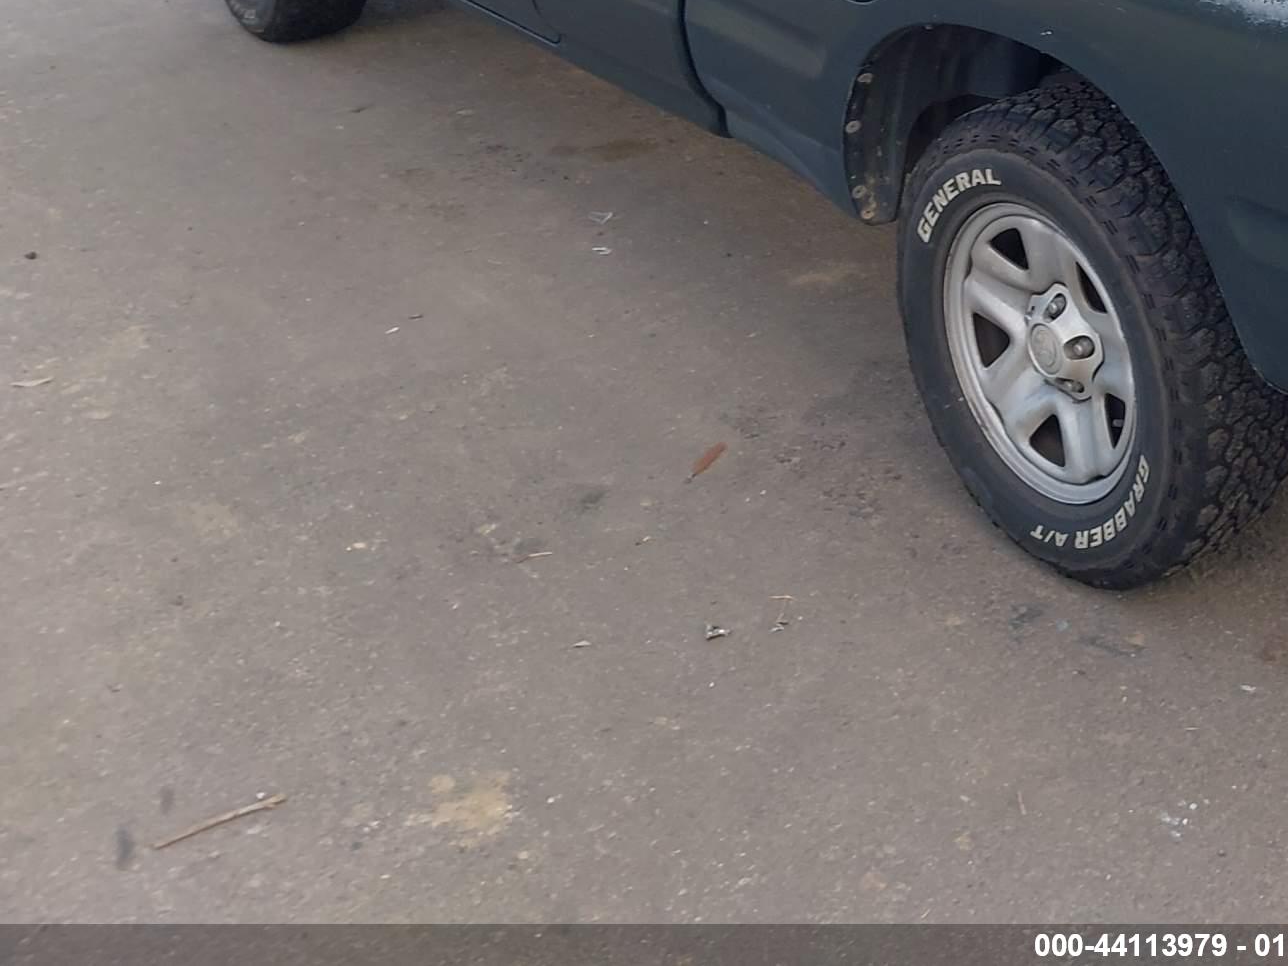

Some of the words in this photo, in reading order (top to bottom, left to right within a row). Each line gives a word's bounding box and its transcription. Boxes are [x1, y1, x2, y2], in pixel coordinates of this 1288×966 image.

[917, 168, 1002, 243] GENERAL
[1029, 525, 1069, 547] A/T
[1074, 454, 1150, 549] GRABBER
